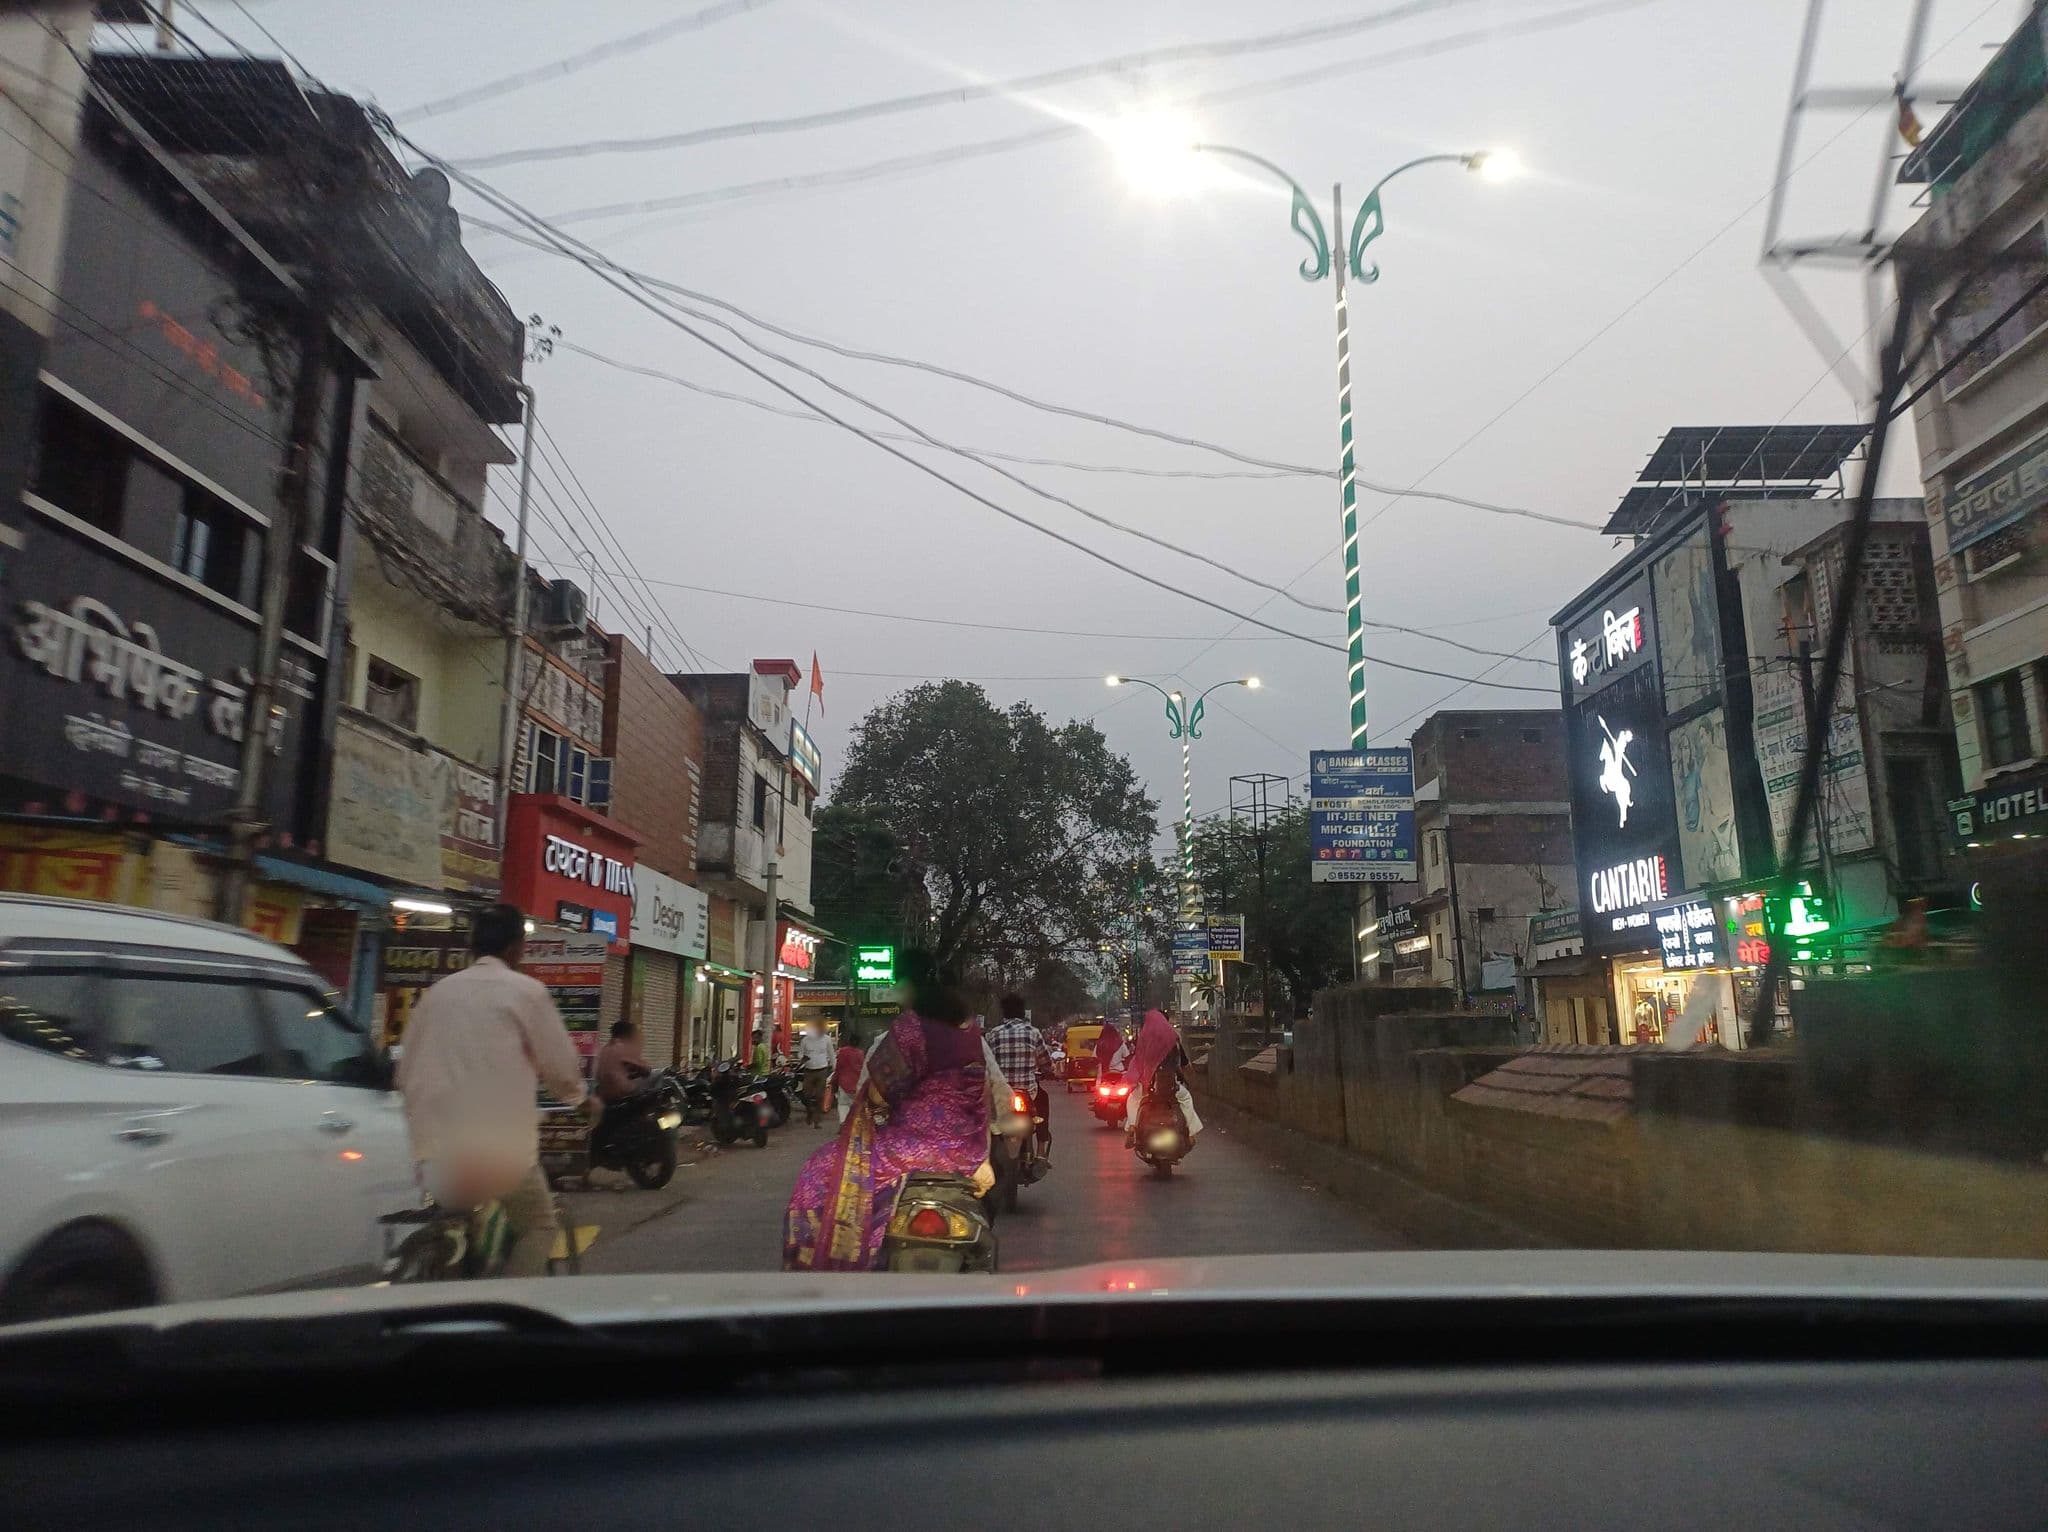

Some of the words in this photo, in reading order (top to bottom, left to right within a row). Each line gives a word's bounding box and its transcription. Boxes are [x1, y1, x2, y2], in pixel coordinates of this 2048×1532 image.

[1328, 756, 1365, 767] BANSAL
[1366, 755, 1409, 767] CLASSES
[1983, 787, 2048, 825] HOTEL
[1326, 811, 1363, 821] IIT-JEE
[1368, 811, 1399, 821] NEET
[1320, 824, 1364, 835] MHT-CET
[1332, 839, 1394, 848] FOUNDATION
[1591, 855, 1668, 913] CANTABIL
[653, 896, 684, 936] Design
